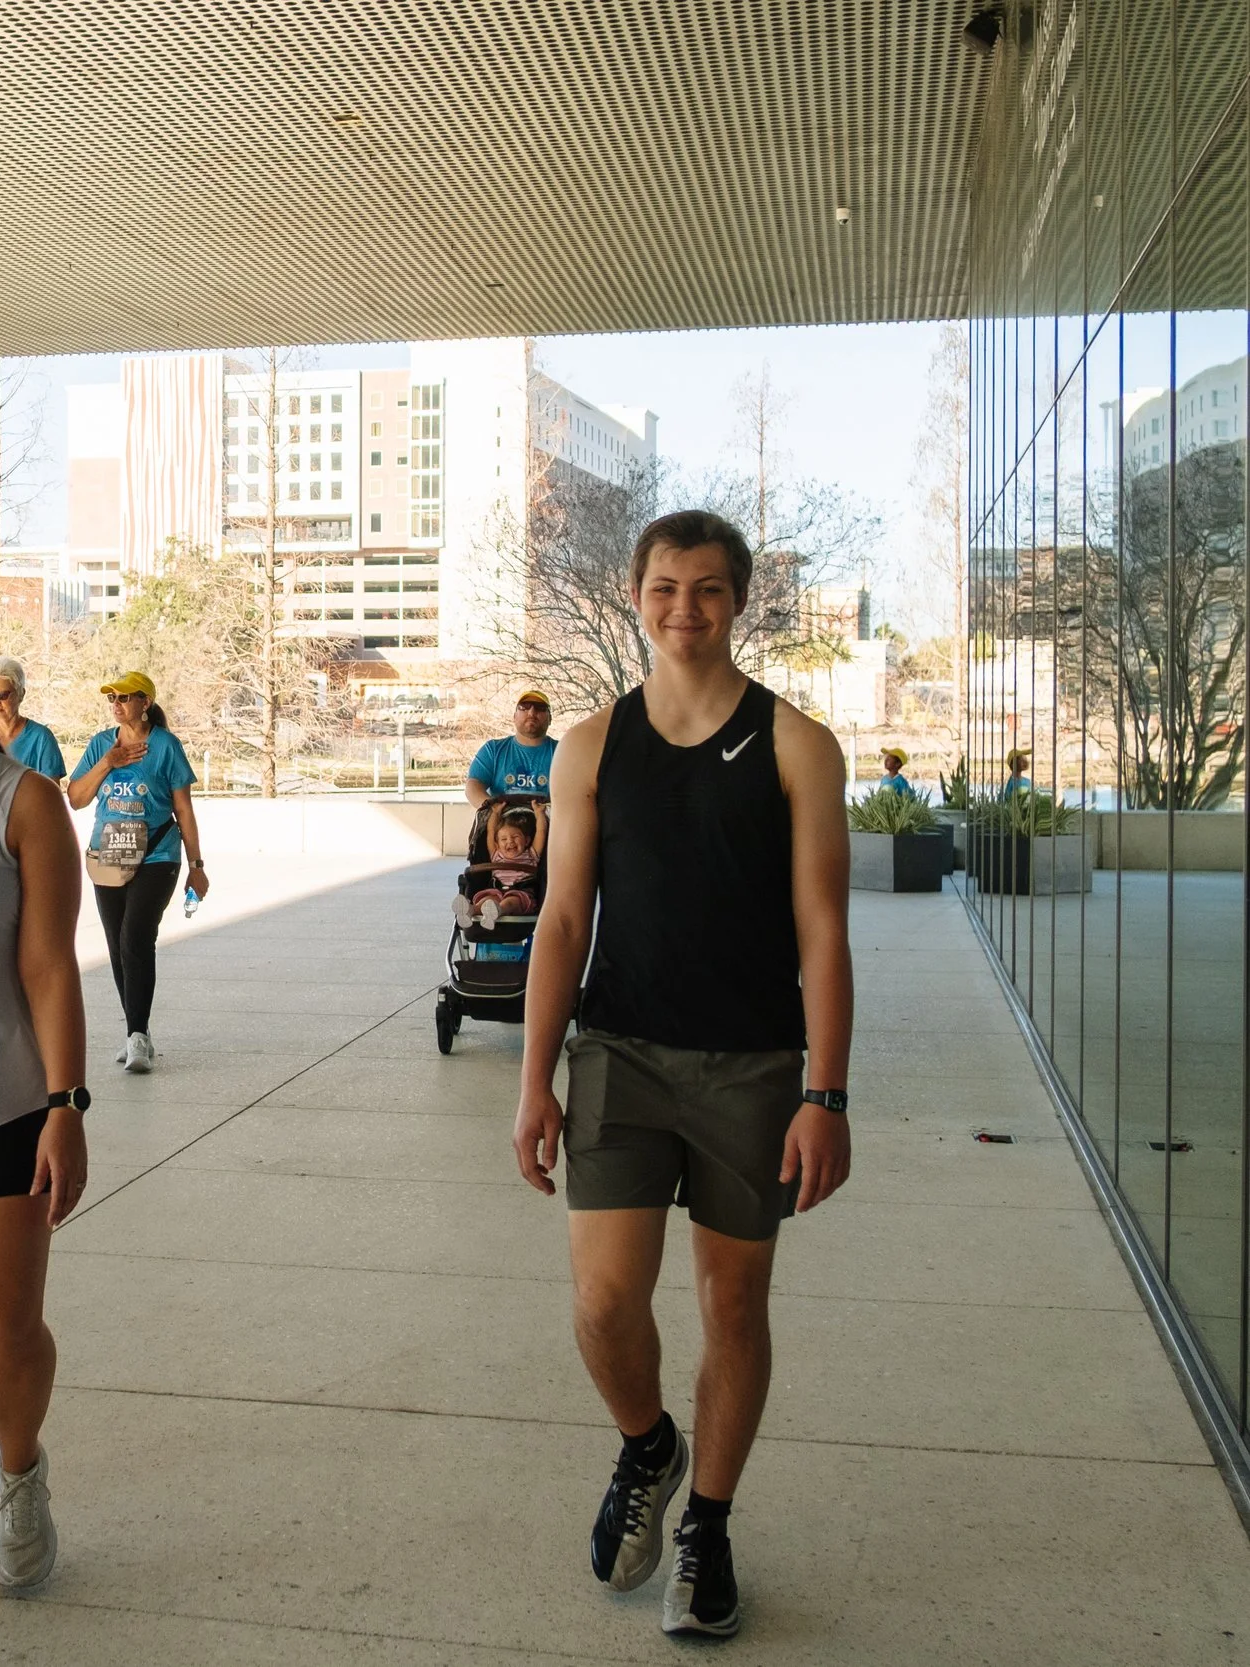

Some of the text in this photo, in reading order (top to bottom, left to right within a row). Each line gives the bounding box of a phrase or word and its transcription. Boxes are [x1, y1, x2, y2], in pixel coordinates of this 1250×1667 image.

[517, 774, 535, 787] 5K
[114, 782, 134, 797] 5K
[109, 832, 137, 843] 13611
